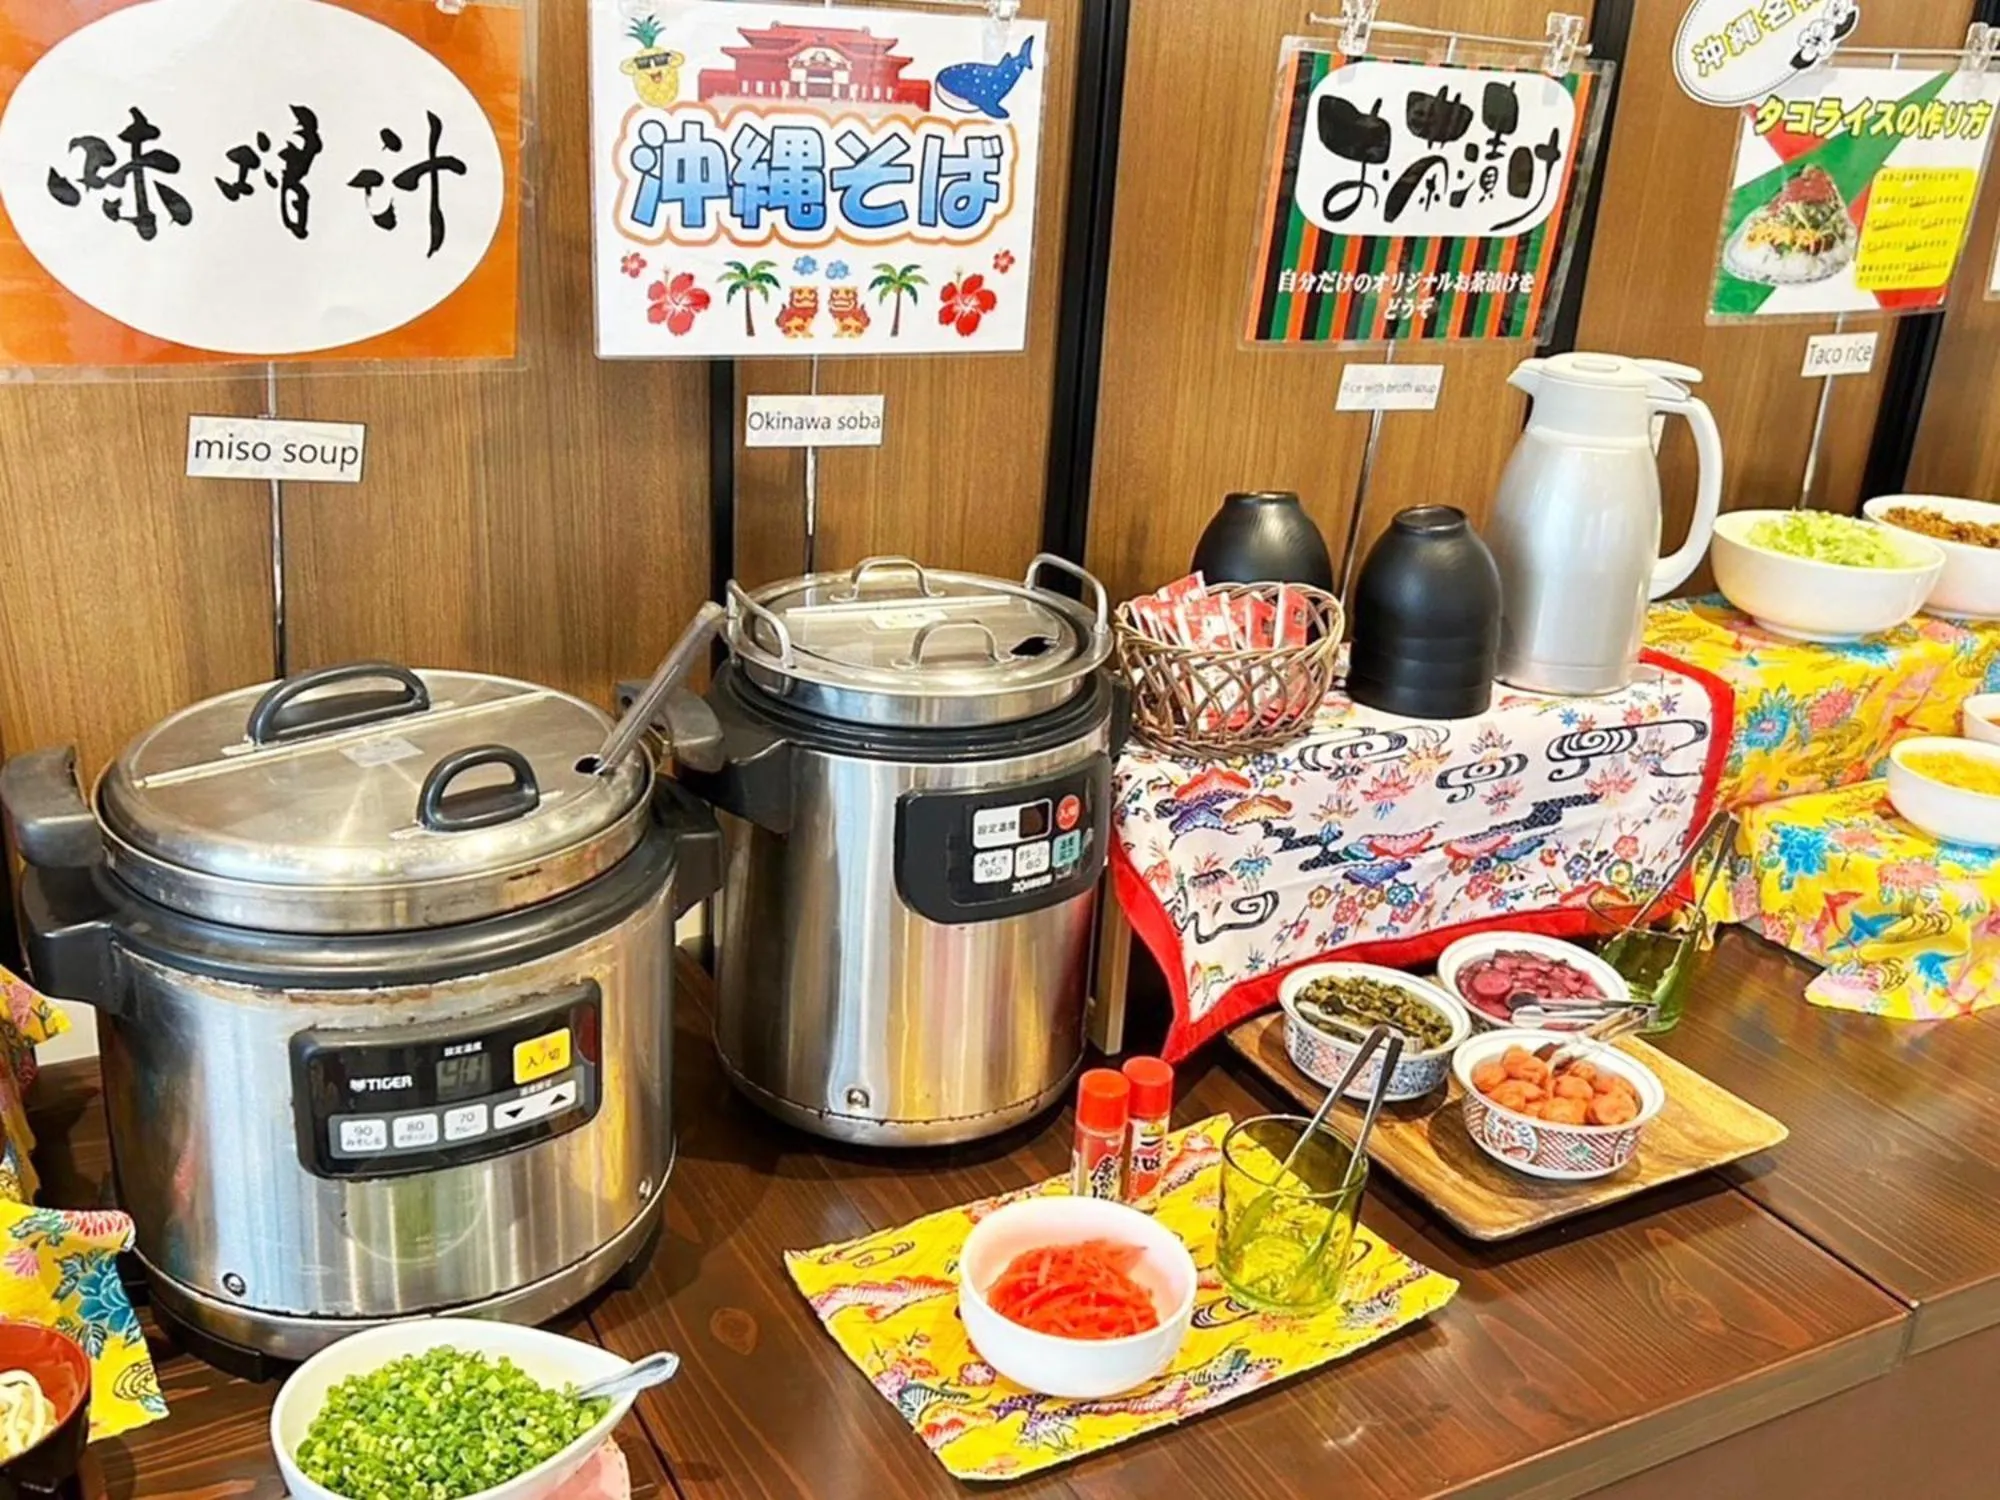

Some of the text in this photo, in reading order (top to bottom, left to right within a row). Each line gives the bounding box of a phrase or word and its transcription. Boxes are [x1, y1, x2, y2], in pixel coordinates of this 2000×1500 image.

[1754, 95, 1992, 140] タコライスの作り方
[1317, 81, 1561, 231] お茶漬け
[48, 104, 467, 257] 味噌汁
[631, 120, 1003, 230] 沖縄そば
[1278, 269, 1535, 293] 自分だけのオリジナルお茶漬けを
[1384, 296, 1434, 319] どうぞ
[1809, 341, 1871, 365] Taco rice
[1386, 381, 1412, 394] broth
[748, 411, 880, 431] Okinawa soba
[194, 433, 359, 472] miso soup
[369, 1075, 412, 1091] TIGER
[354, 1124, 373, 1136] 90
[459, 1112, 476, 1124] 70
